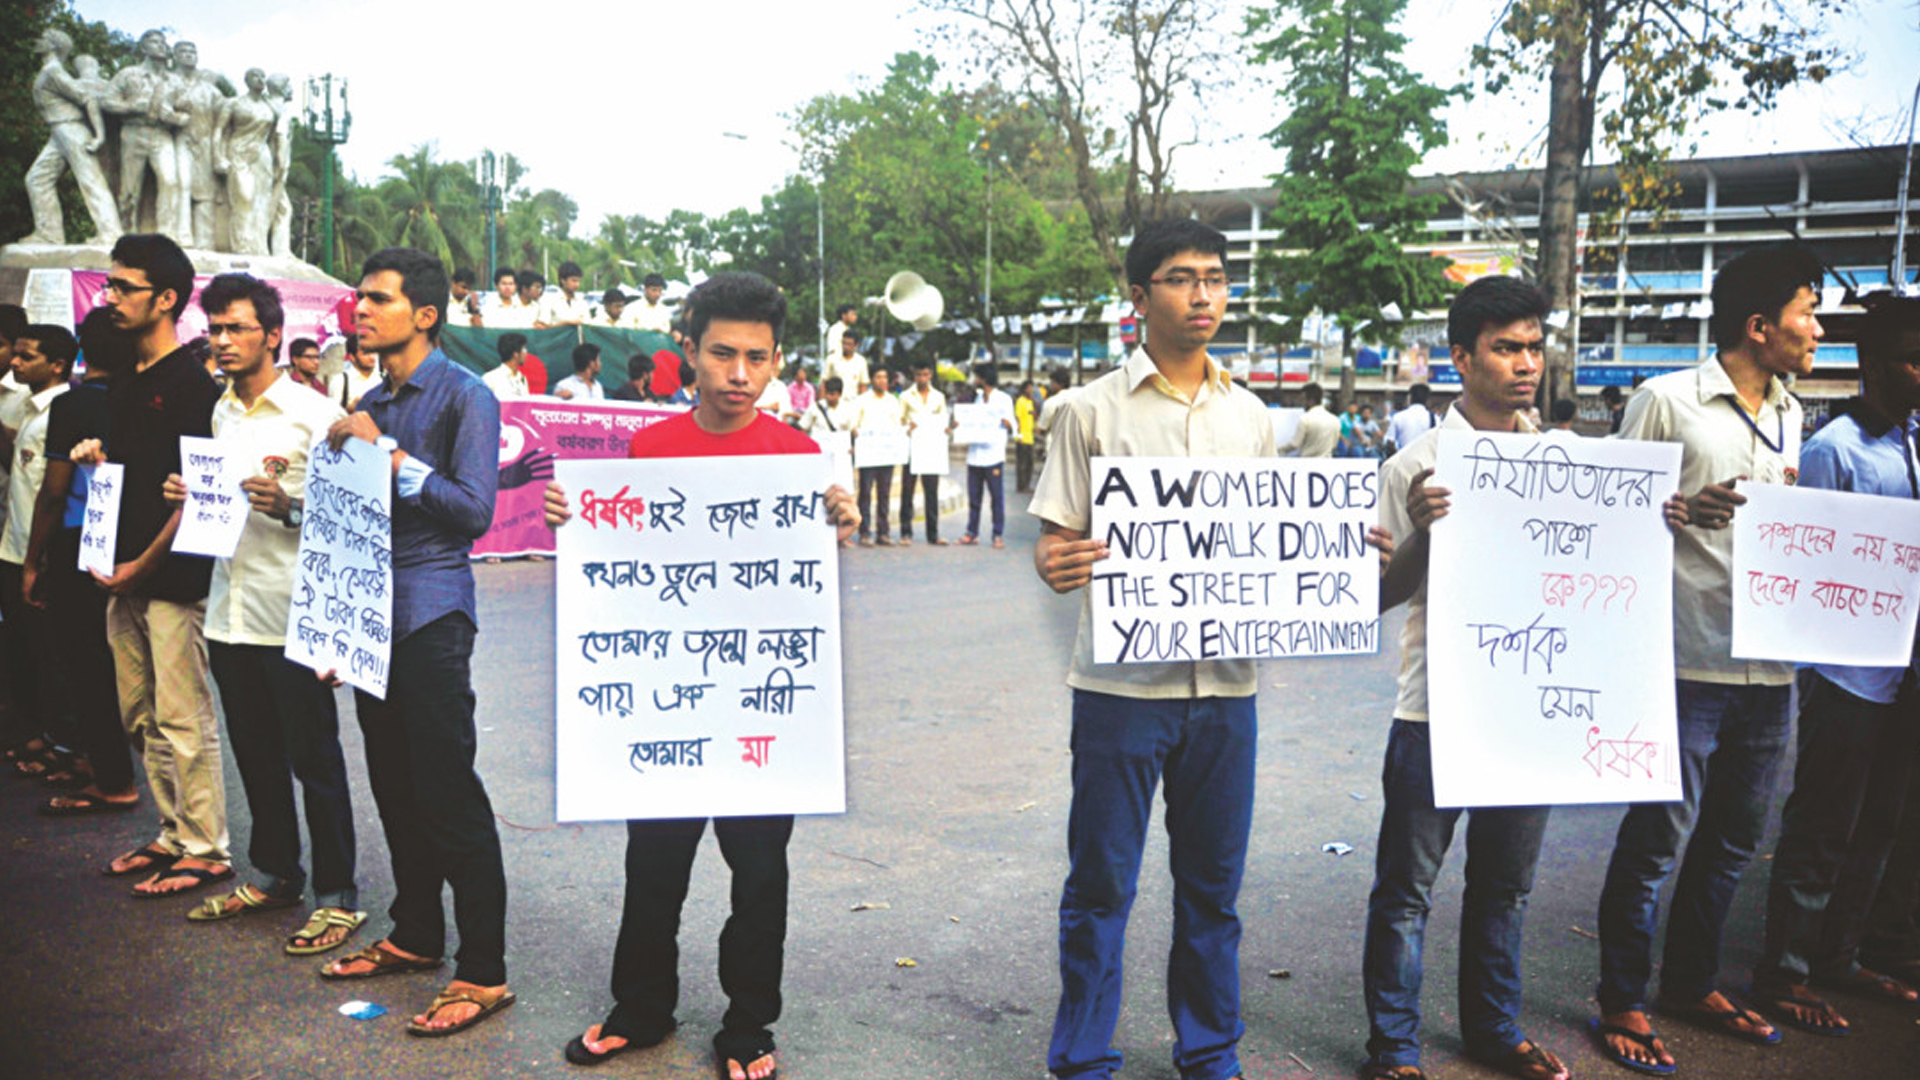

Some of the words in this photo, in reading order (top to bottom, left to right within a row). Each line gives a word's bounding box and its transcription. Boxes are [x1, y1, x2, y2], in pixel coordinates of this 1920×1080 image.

[1094, 467, 1138, 507] A
[1151, 468, 1296, 508] WOMEN
[1308, 471, 1377, 510] DOES
[1463, 438, 1668, 508] নির্যাতিতাদের
[580, 485, 645, 532] ধর্ষক,
[1106, 519, 1180, 562] NOT
[1183, 521, 1267, 560] WALK
[1279, 521, 1366, 561] DOWN
[1523, 518, 1598, 560] পাশে
[582, 560, 655, 589] কখনও
[660, 560, 717, 607] ভুলে
[730, 558, 779, 590] যাস
[1093, 572, 1158, 607] THE
[1169, 572, 1277, 607] STREET
[1297, 572, 1359, 605] FOR
[1748, 571, 1800, 606] দেশে
[578, 630, 672, 663] তোমার
[1112, 618, 1193, 663] YOUR
[1200, 619, 1380, 658] ENTERTAINMENT
[1466, 613, 1567, 675] দর্শক
[578, 682, 634, 717] পায়
[653, 683, 716, 711] এক
[1537, 686, 1602, 721] যেন
[628, 737, 712, 773] তোমার
[737, 735, 776, 768] মা
